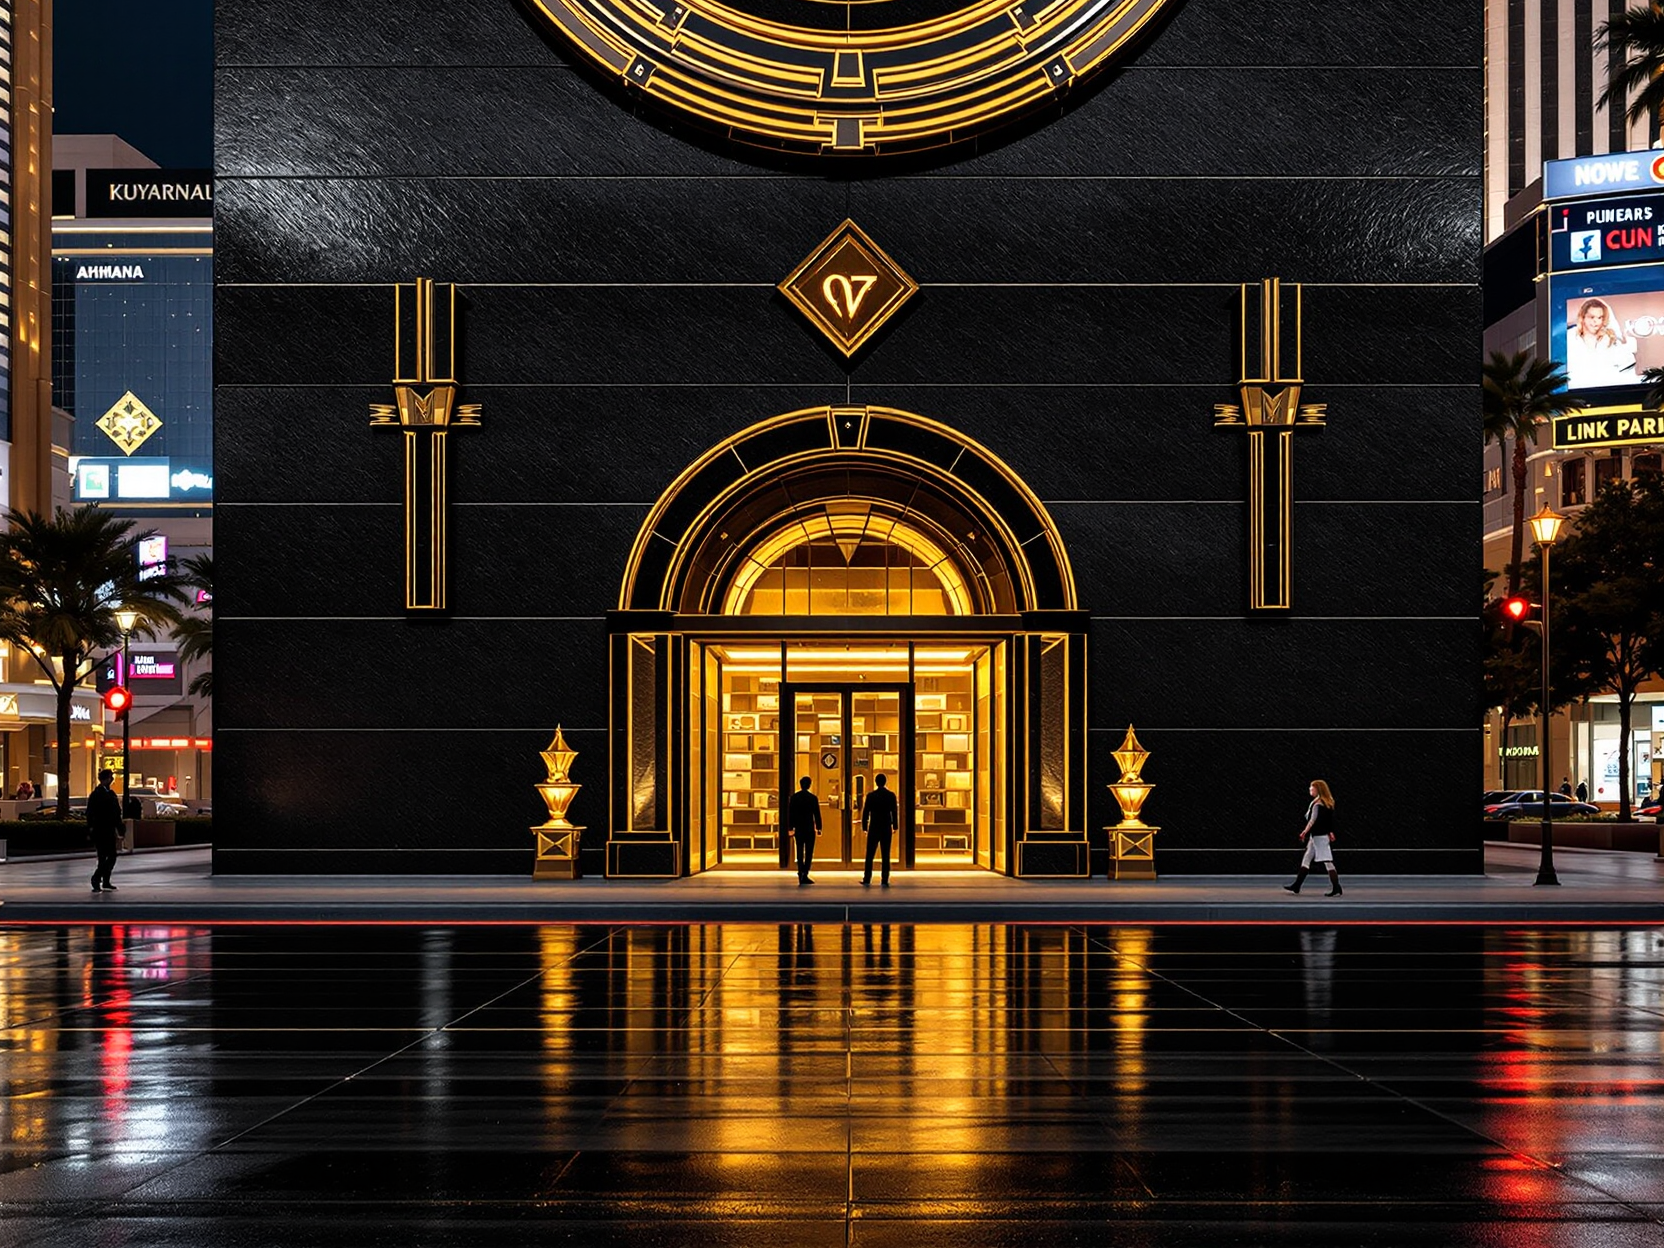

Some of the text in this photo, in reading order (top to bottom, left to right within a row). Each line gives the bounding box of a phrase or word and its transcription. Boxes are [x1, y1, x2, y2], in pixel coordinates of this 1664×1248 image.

[1575, 160, 1640, 186] NOWE
[109, 183, 213, 201] KUYARNAL
[1606, 227, 1653, 250] CUN
[1567, 420, 1610, 441] LINK
